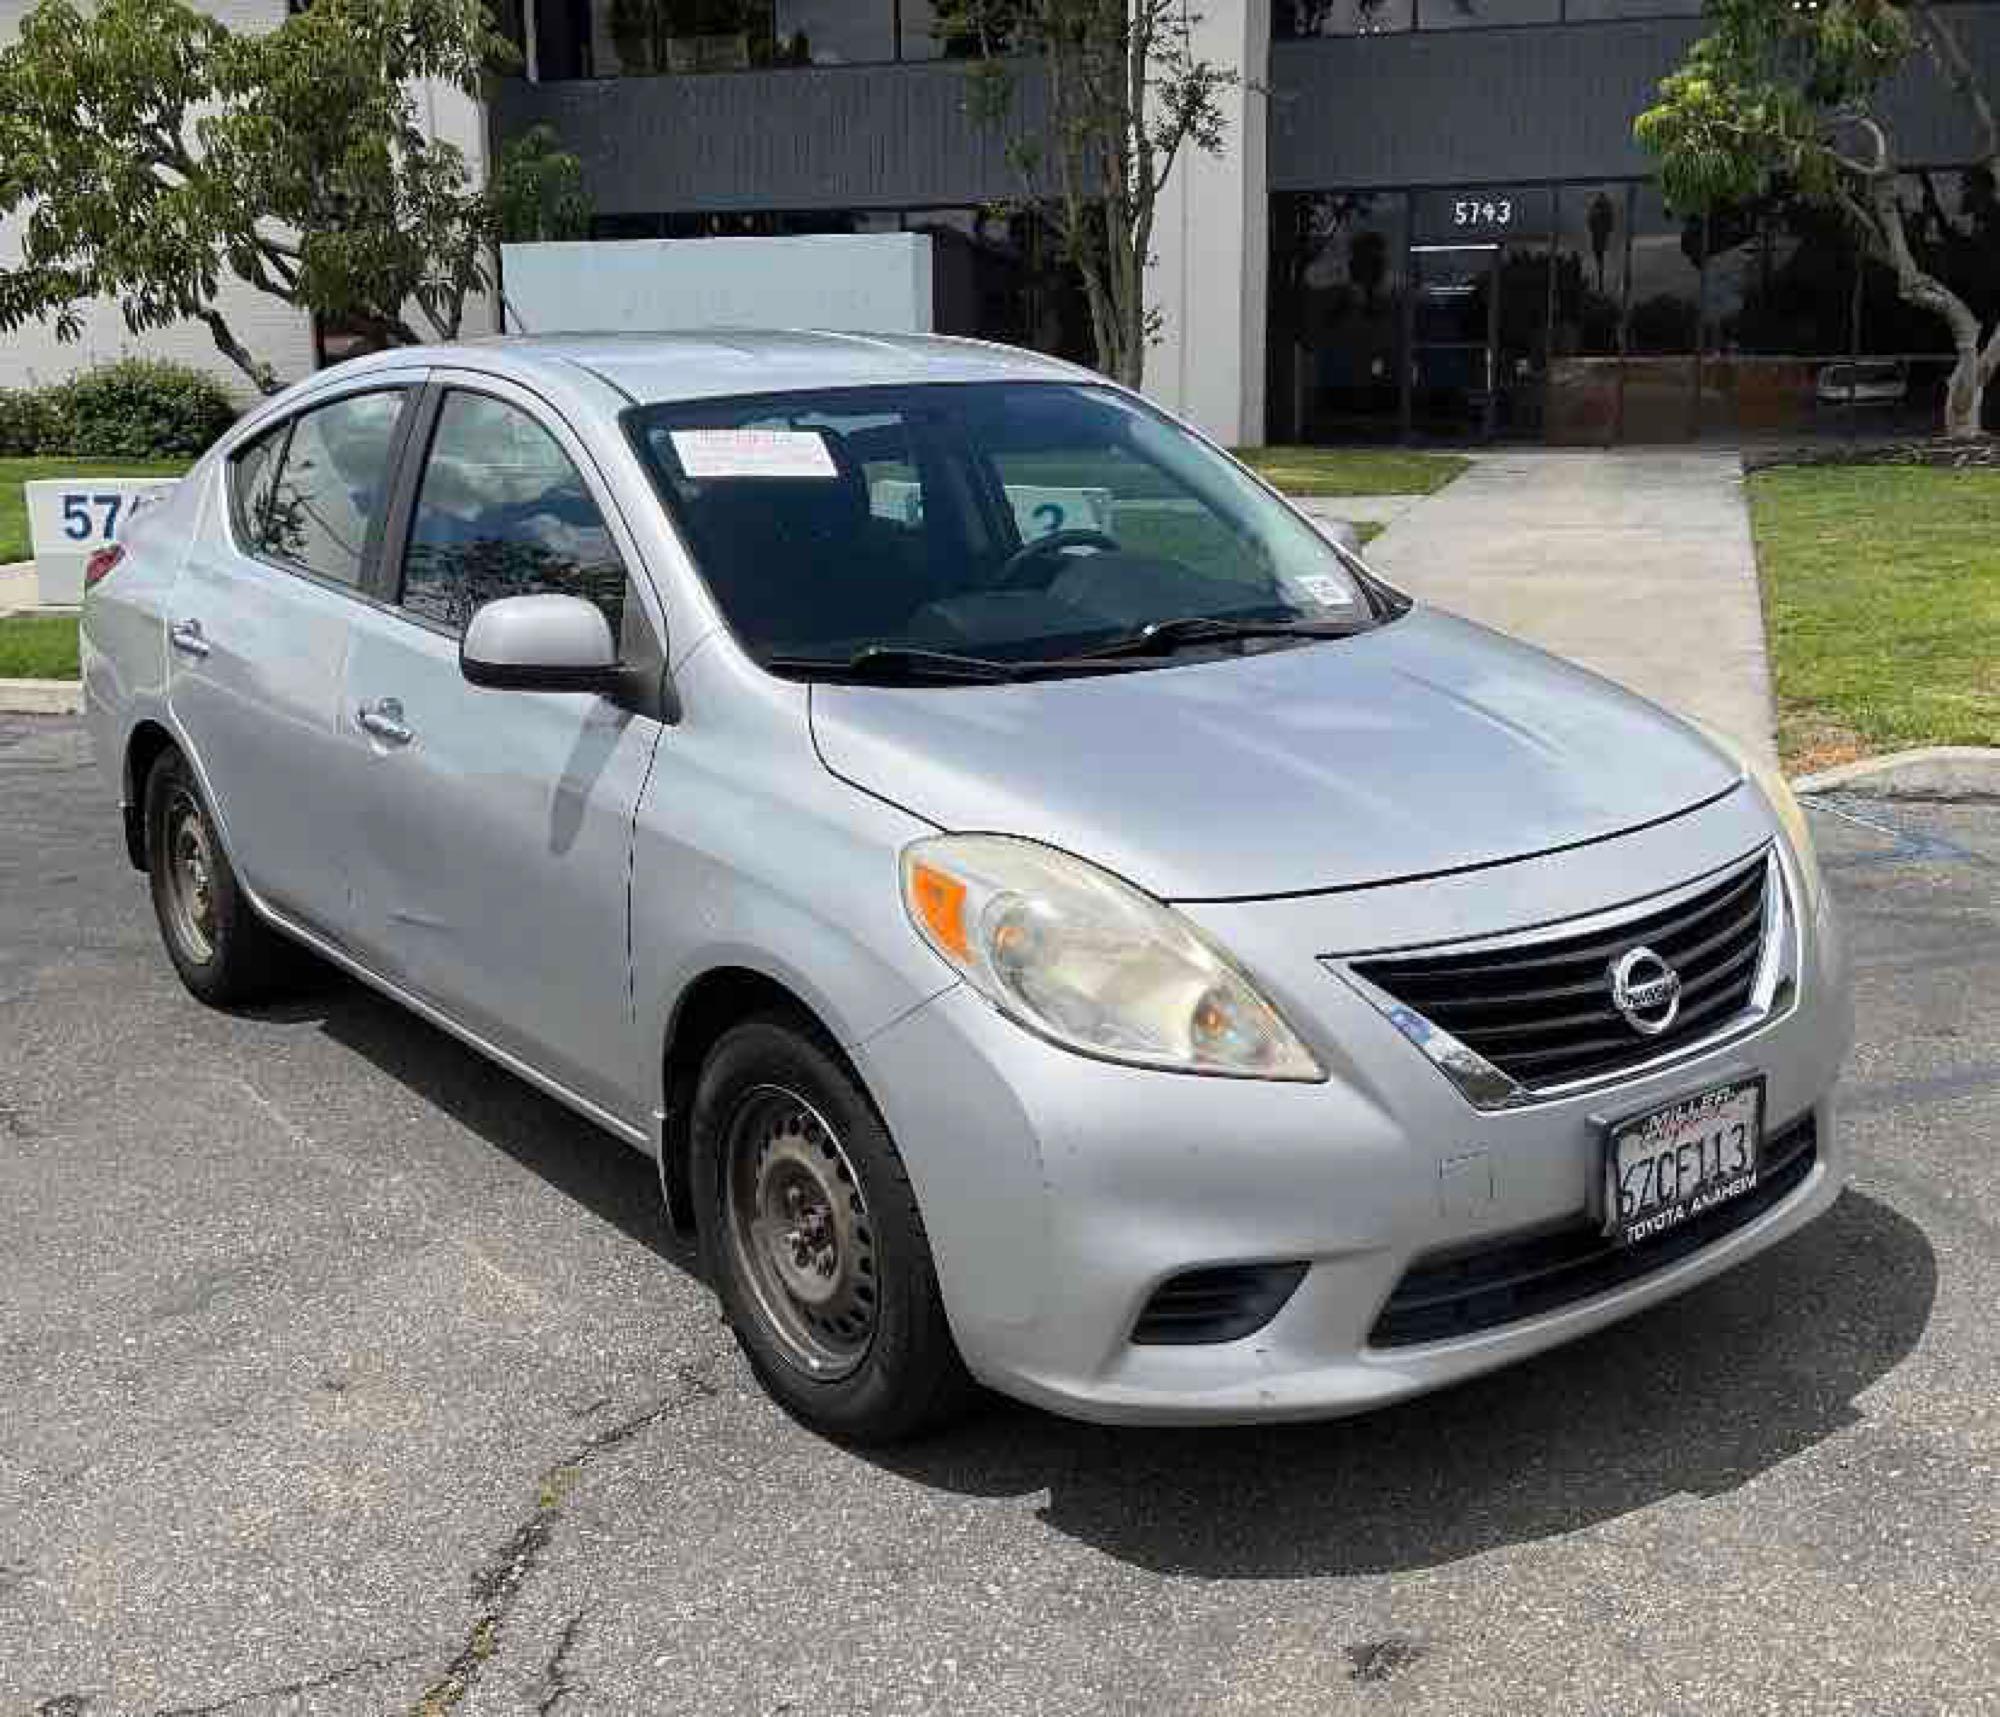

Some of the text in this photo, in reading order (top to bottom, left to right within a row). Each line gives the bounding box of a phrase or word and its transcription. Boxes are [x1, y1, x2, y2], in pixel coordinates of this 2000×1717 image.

[64, 494, 139, 540] 57
[1626, 1171, 1757, 1246] TOYOTA ANAHEIM
